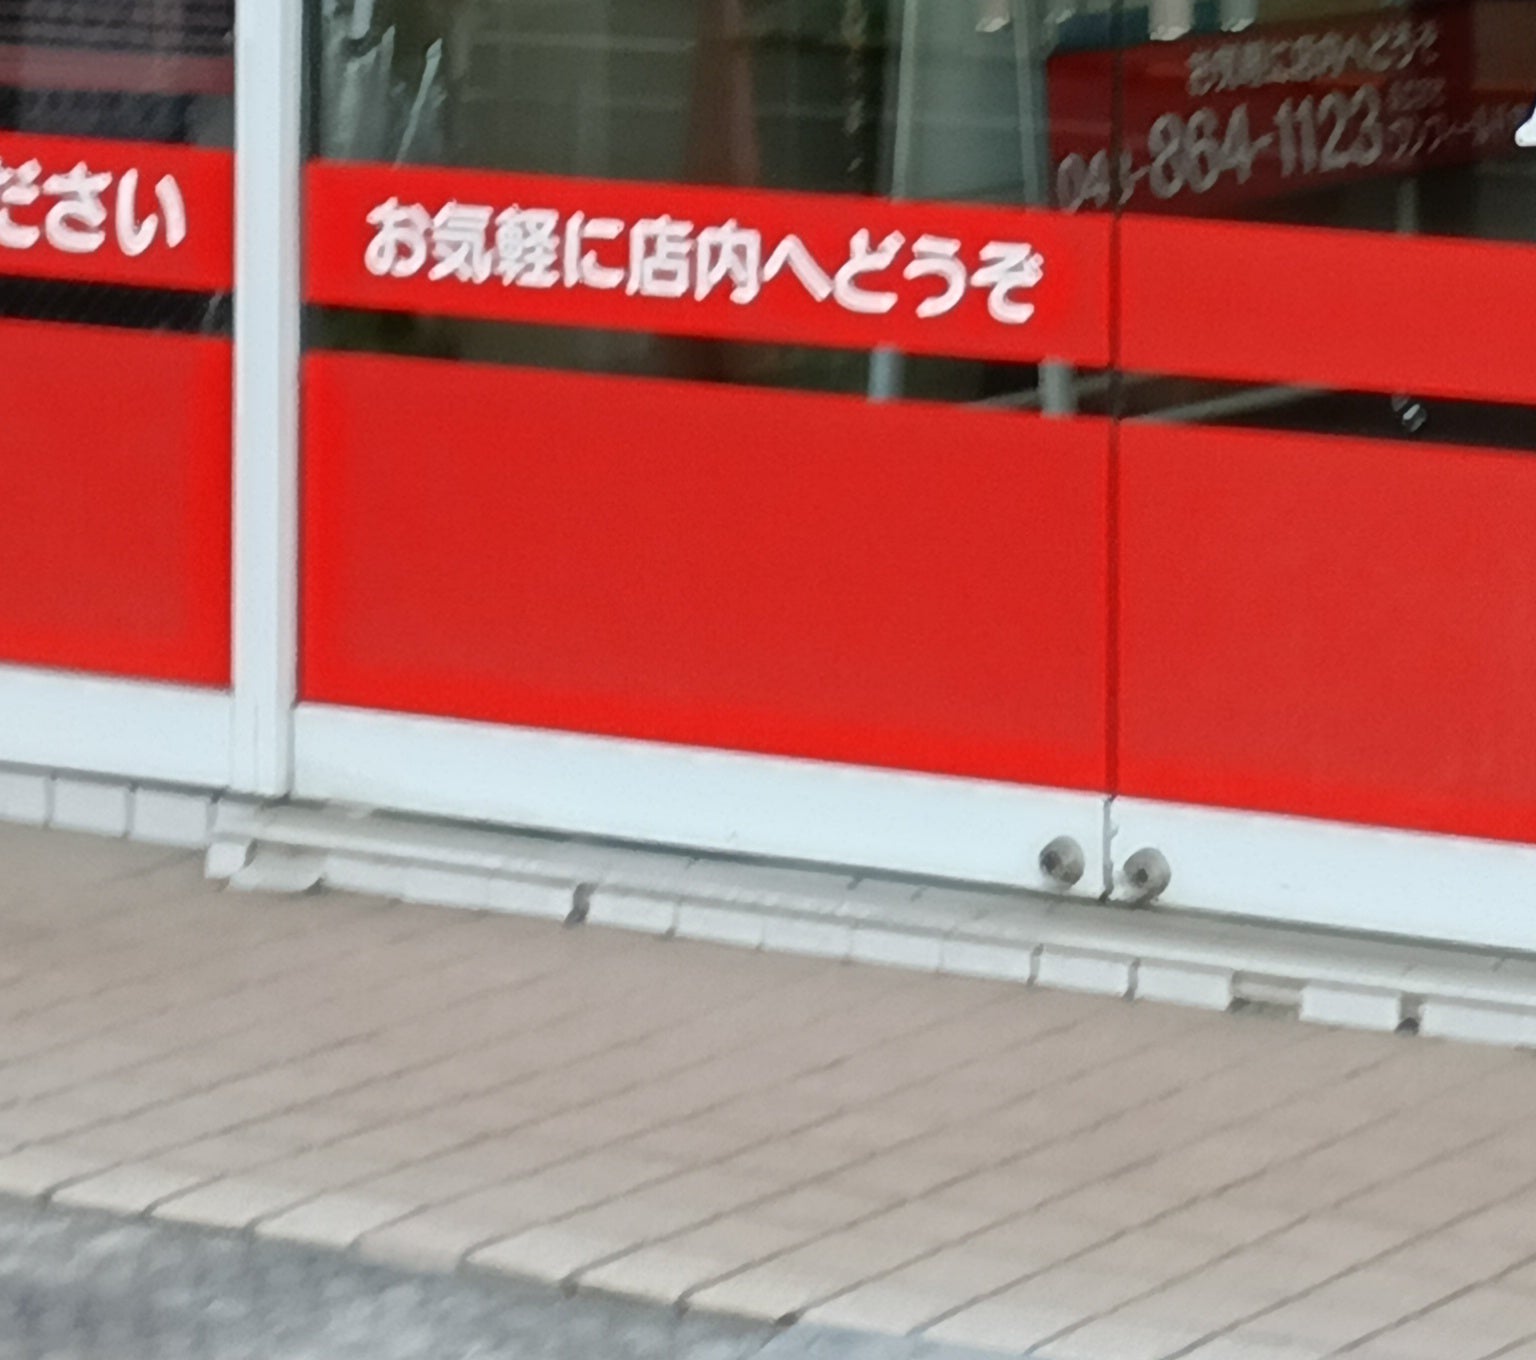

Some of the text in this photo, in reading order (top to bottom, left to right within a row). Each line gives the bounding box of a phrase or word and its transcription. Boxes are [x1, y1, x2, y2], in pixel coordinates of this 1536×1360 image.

[364, 196, 1044, 325] お気軽に店内へどうぞ
